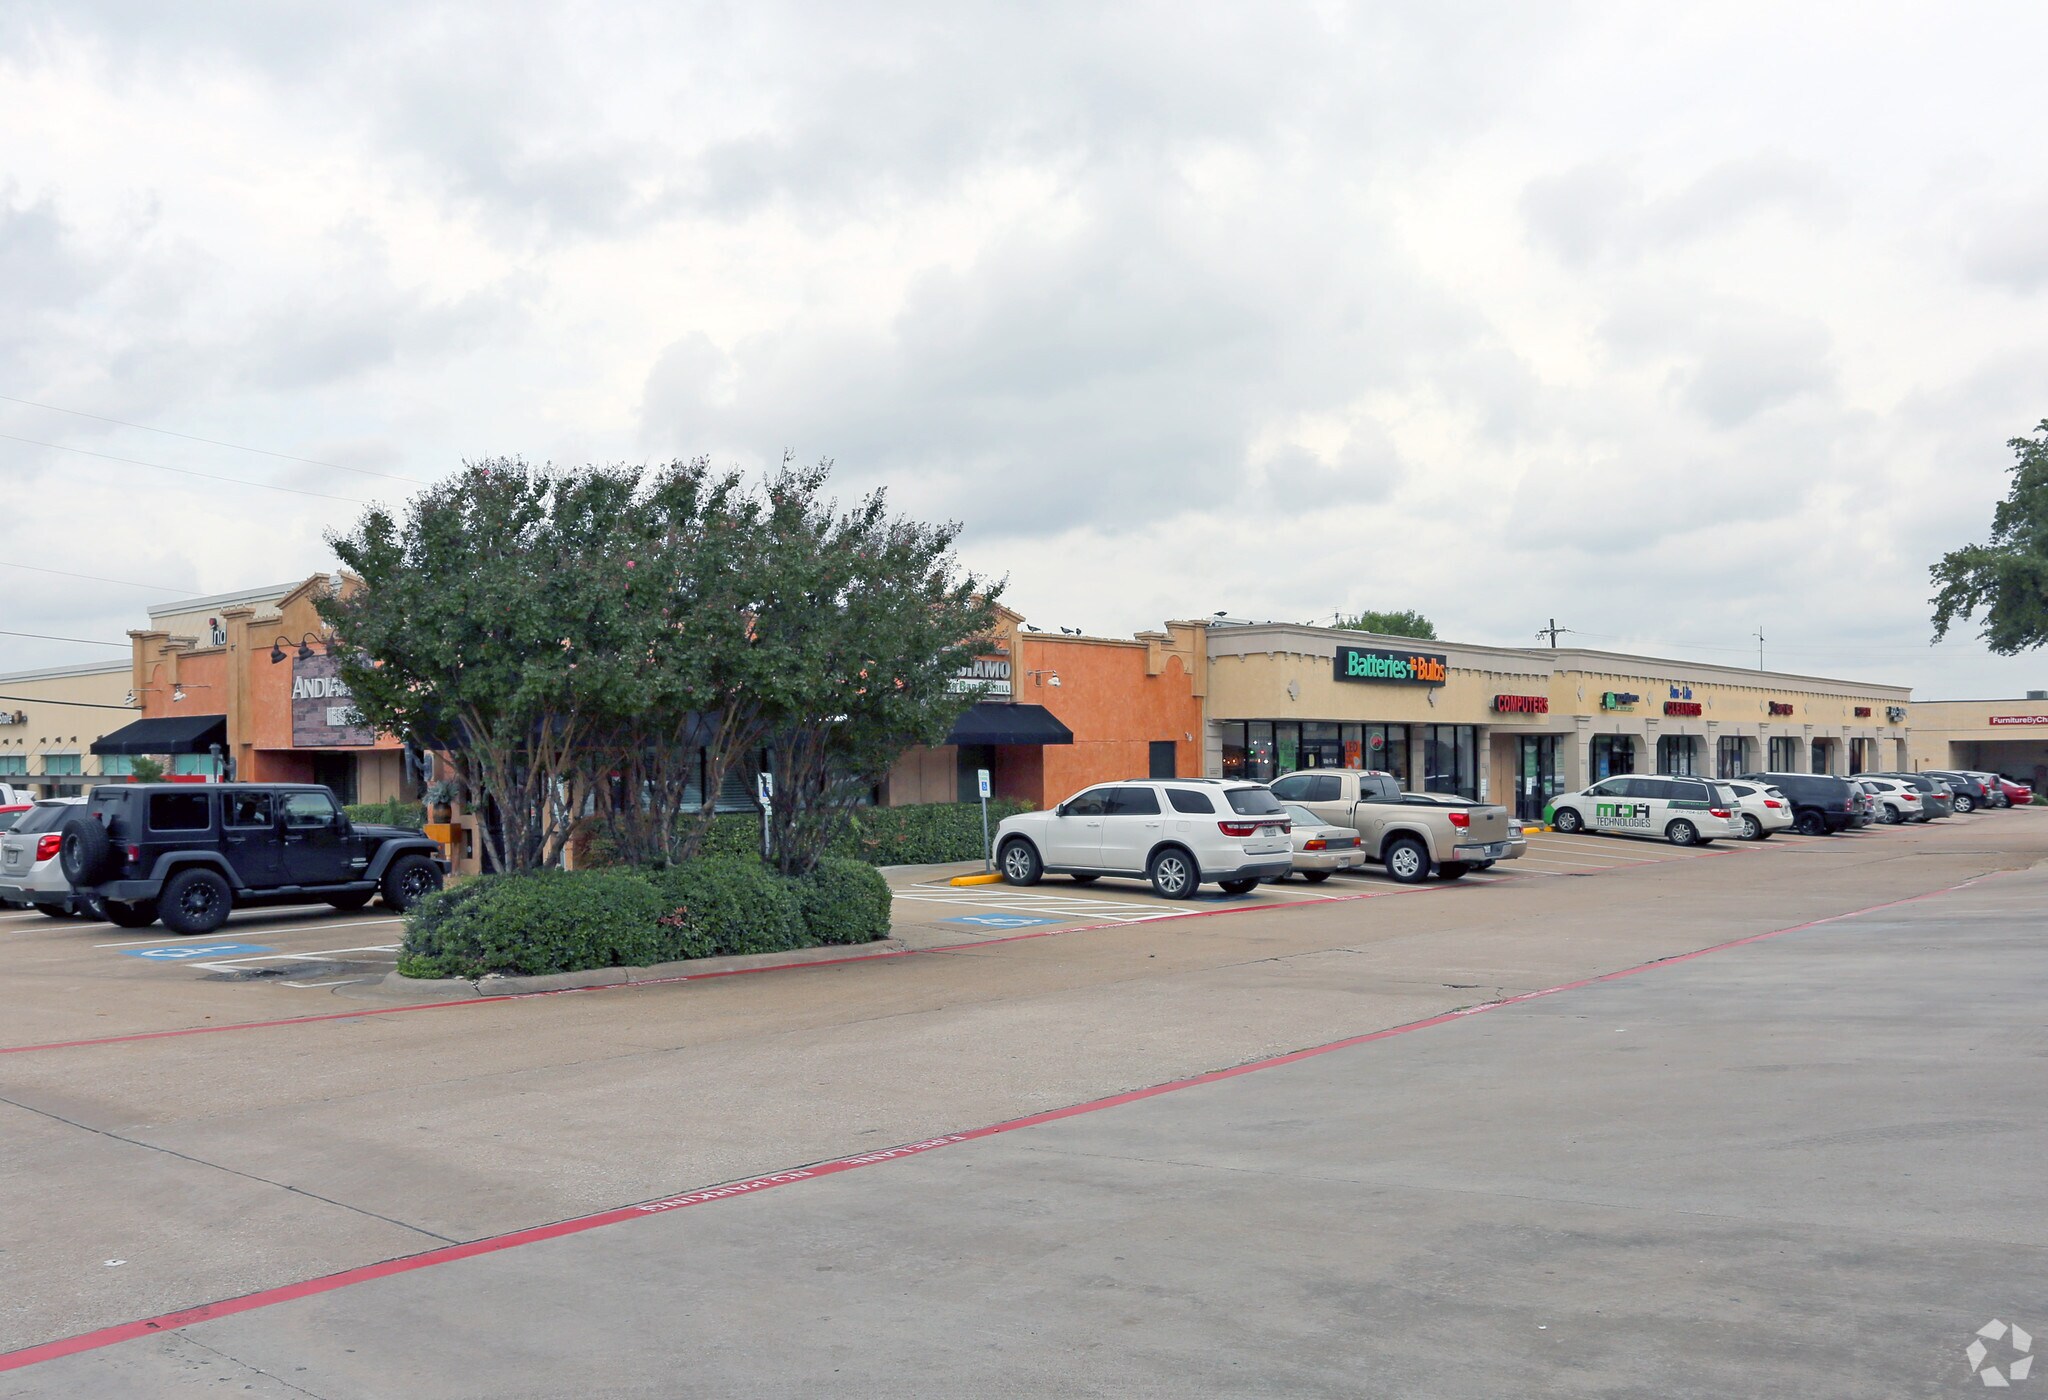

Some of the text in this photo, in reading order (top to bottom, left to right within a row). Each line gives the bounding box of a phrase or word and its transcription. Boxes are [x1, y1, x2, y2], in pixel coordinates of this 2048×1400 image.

[292, 675, 352, 699] ANDIA
[1498, 695, 1549, 714] COMPUTERS
[1596, 817, 1651, 828] TECHNOLOGIES
